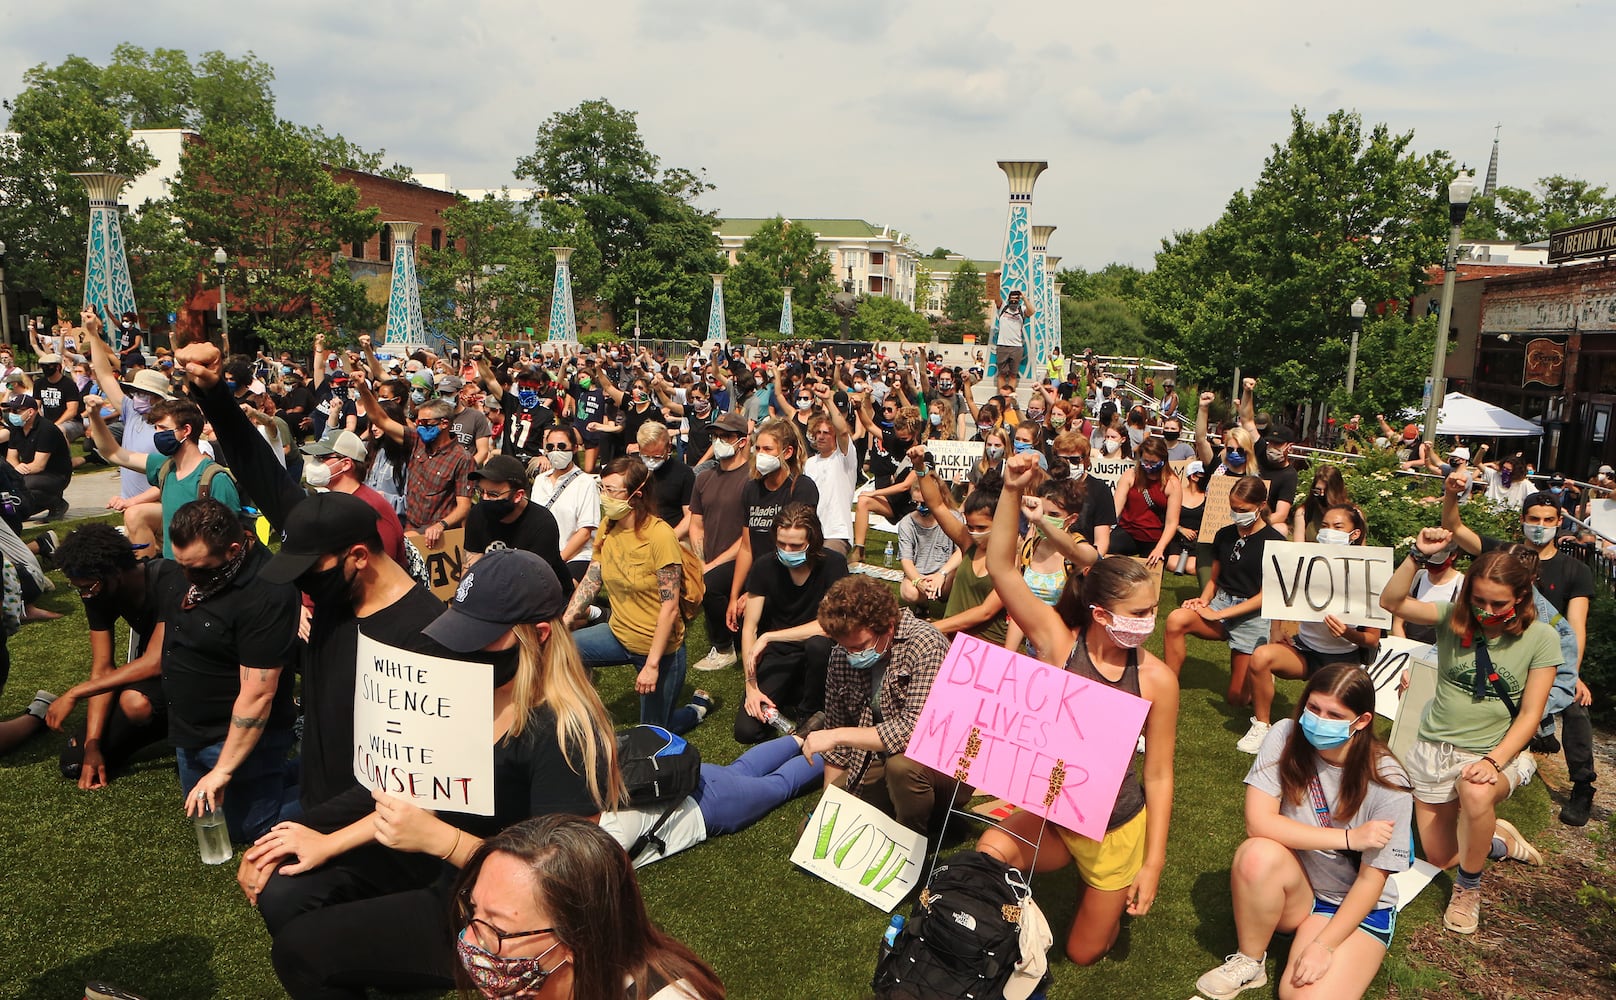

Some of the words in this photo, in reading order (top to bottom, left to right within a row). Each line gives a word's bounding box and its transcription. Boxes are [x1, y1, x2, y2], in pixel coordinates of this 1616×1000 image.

[1563, 230, 1600, 254] IBERIAN
[935, 454, 961, 467] LACK
[938, 467, 971, 481] ATTER
[749, 517, 773, 527] Atlan
[750, 505, 775, 517] Made
[1271, 554, 1387, 620] VOTE
[373, 655, 428, 684] WHITE
[947, 637, 1090, 740] BLACK
[363, 673, 452, 718] SILENCE
[974, 698, 1051, 748] LIVES
[369, 733, 434, 765] WHITE
[913, 708, 1090, 823] MATTER
[357, 744, 472, 805] CONSENT
[813, 801, 915, 898] VOTE
